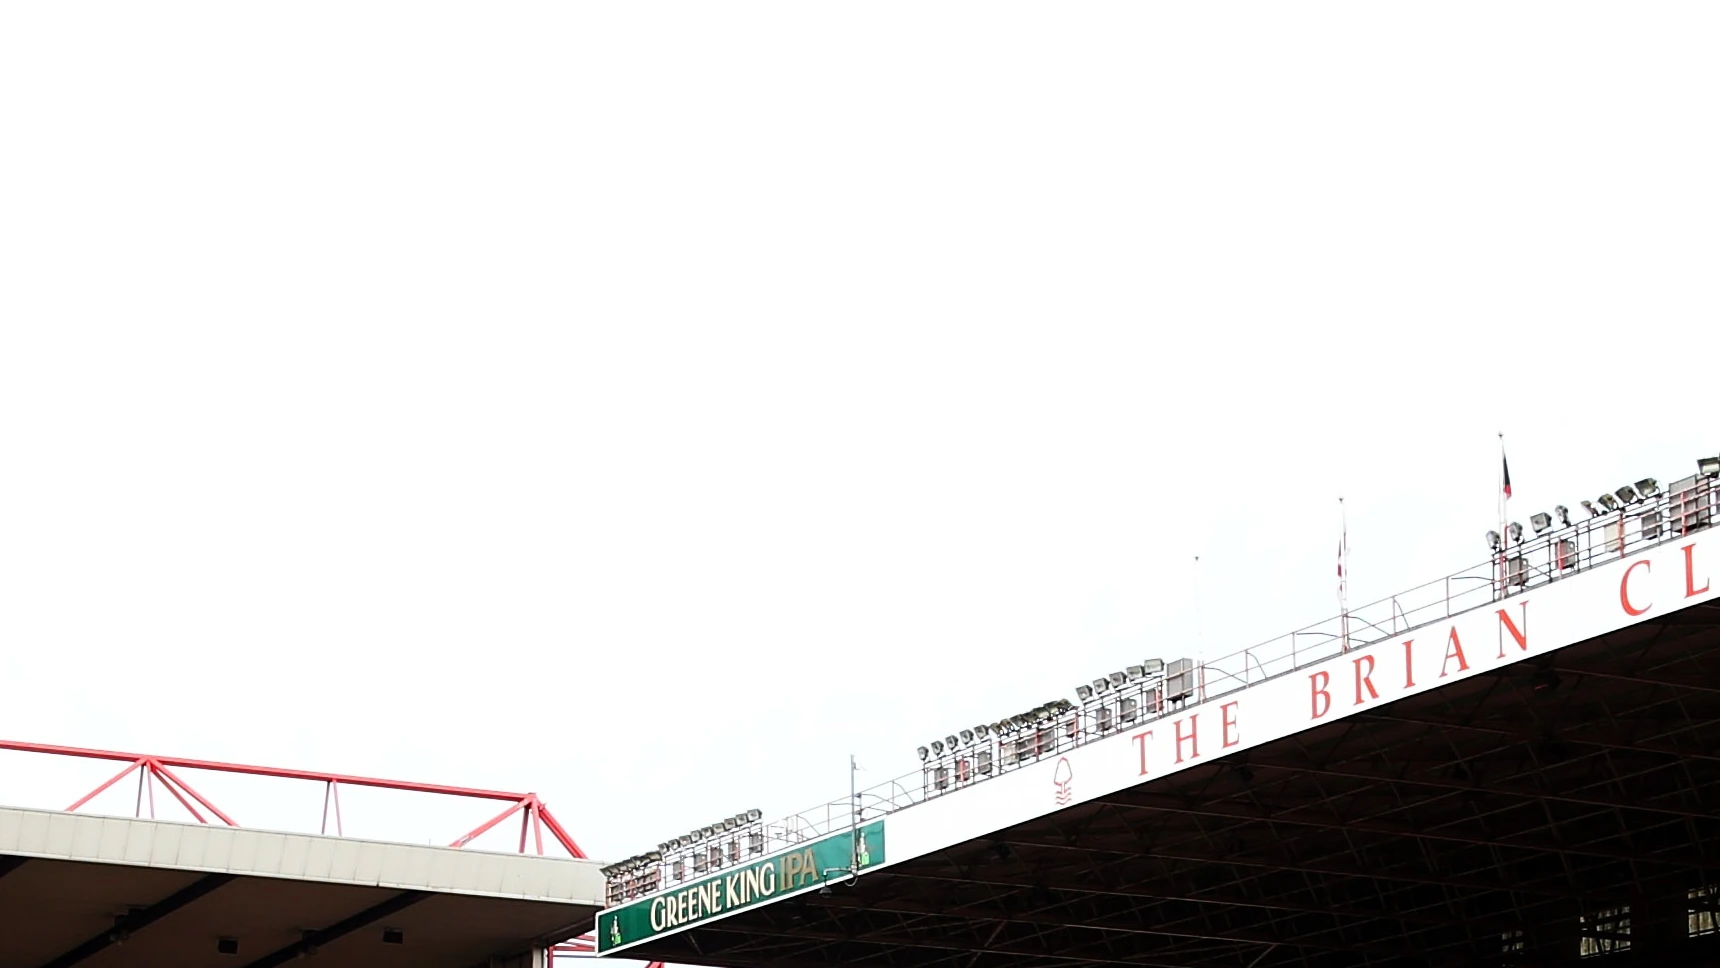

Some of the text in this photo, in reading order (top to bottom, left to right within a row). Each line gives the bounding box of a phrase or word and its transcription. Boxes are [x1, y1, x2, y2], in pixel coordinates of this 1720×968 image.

[1132, 701, 1240, 776] THE
[1309, 600, 1530, 720] BRIAN
[651, 848, 819, 932] GREENE KING IPA
